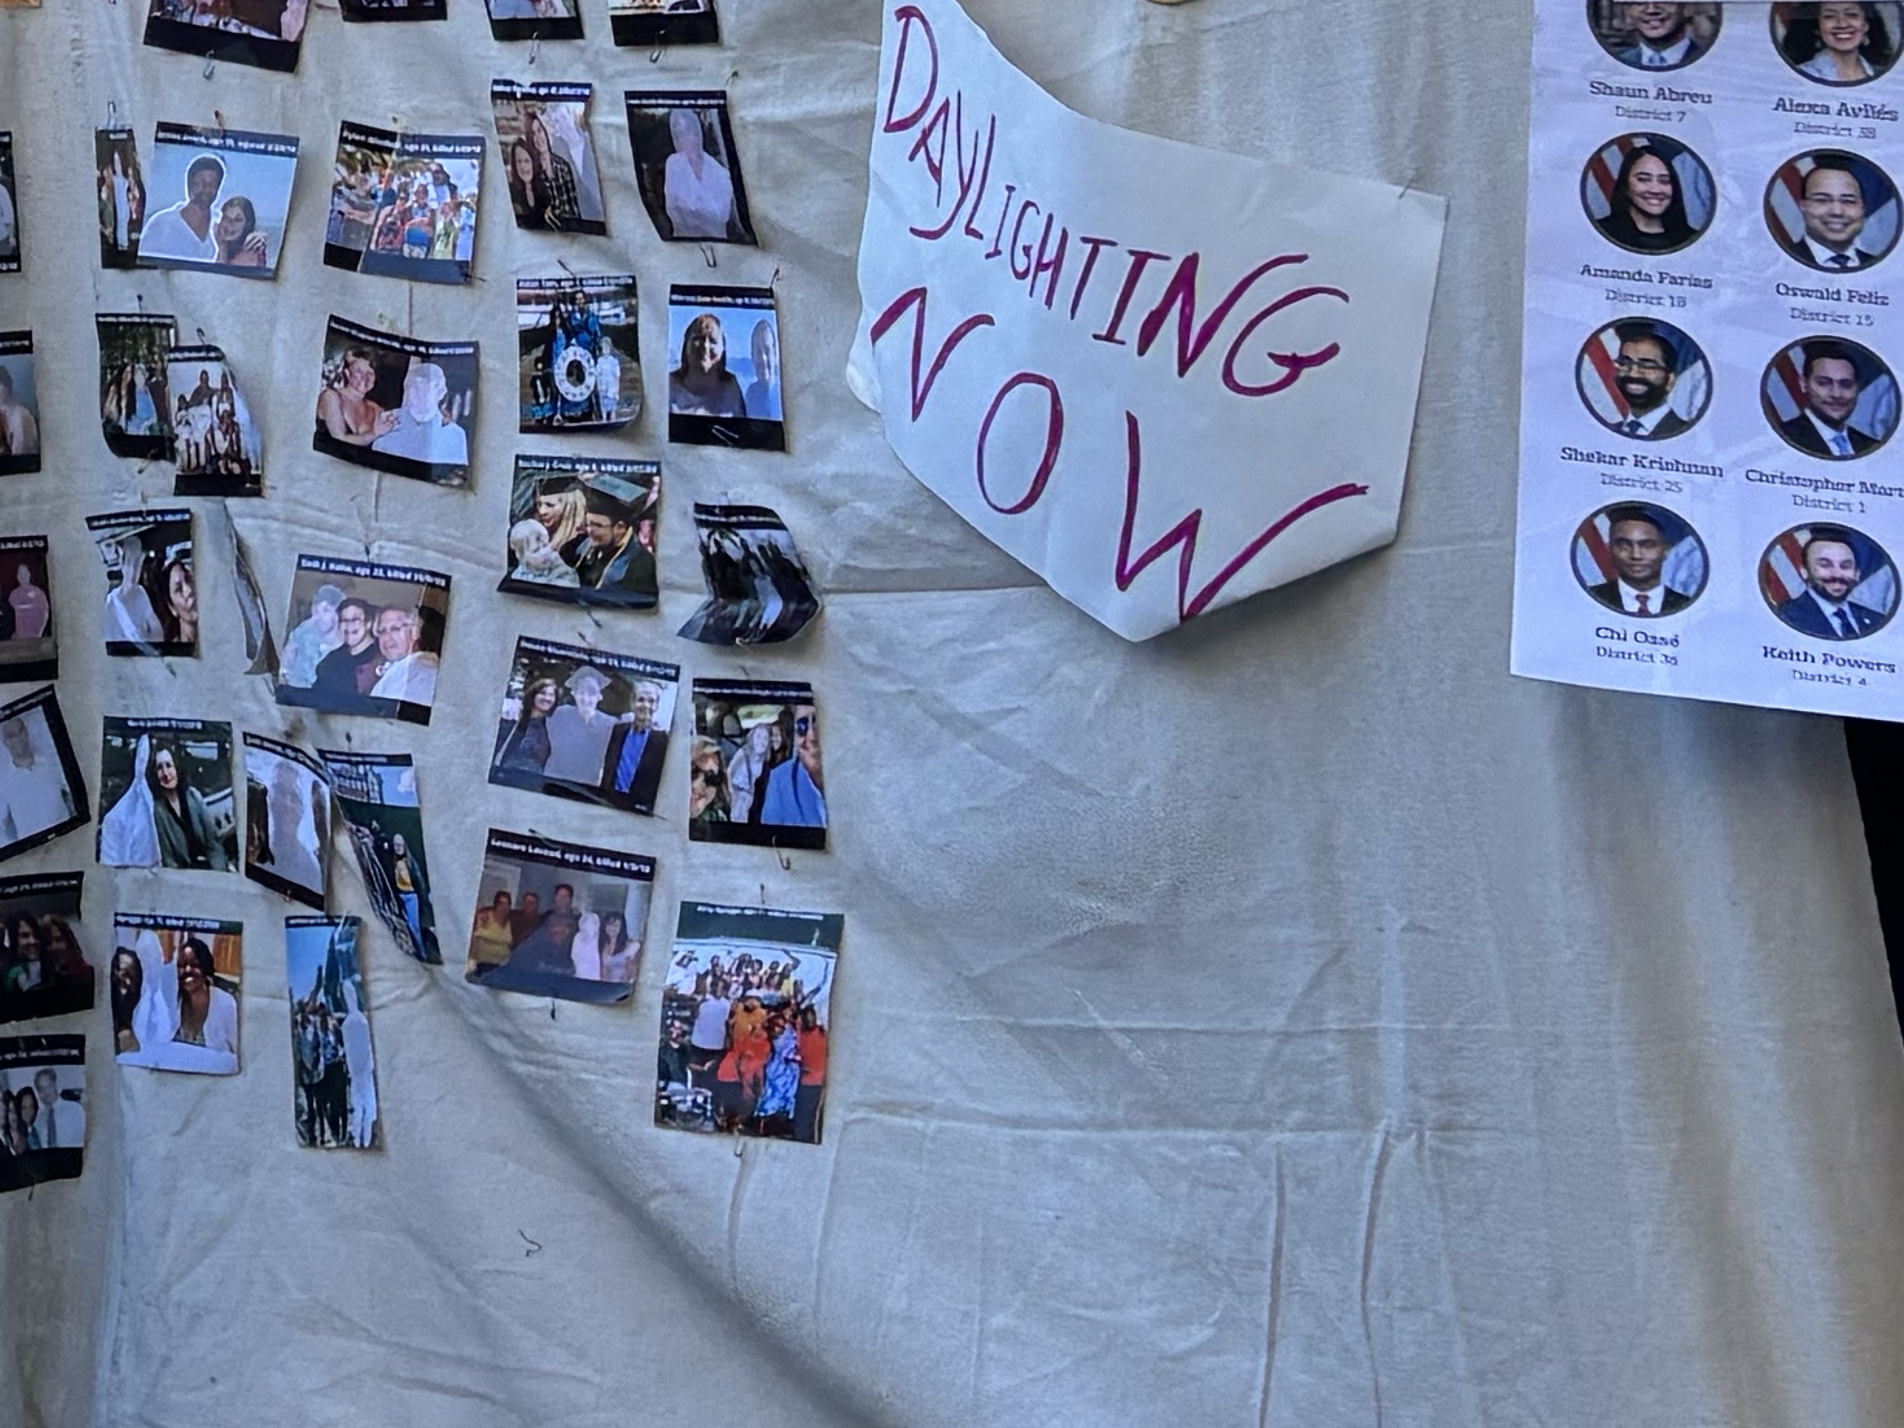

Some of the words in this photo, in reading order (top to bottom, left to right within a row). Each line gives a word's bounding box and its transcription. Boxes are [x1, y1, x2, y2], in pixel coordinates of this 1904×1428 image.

[1589, 80, 1649, 99] Shaun
[1654, 85, 1713, 105] Abreu
[1615, 105, 1673, 121] District
[1773, 97, 1831, 117] Alexa
[1793, 121, 1852, 138] District
[882, 5, 1350, 397] DAYLIGHTING
[1580, 264, 1654, 283] Amanda
[1605, 288, 1664, 306] District
[1775, 282, 1843, 302] Oswald
[1847, 288, 1890, 306] Feliz
[1790, 307, 1851, 324] District
[869, 286, 1370, 625] NOW
[1560, 446, 1630, 467] Shekar
[1600, 472, 1659, 491] District
[1745, 468, 1857, 493] Christopher
[1792, 494, 1854, 513] District
[1596, 646, 1656, 664] District
[1762, 645, 1817, 664] Keith
[1821, 652, 1897, 675] Powers
